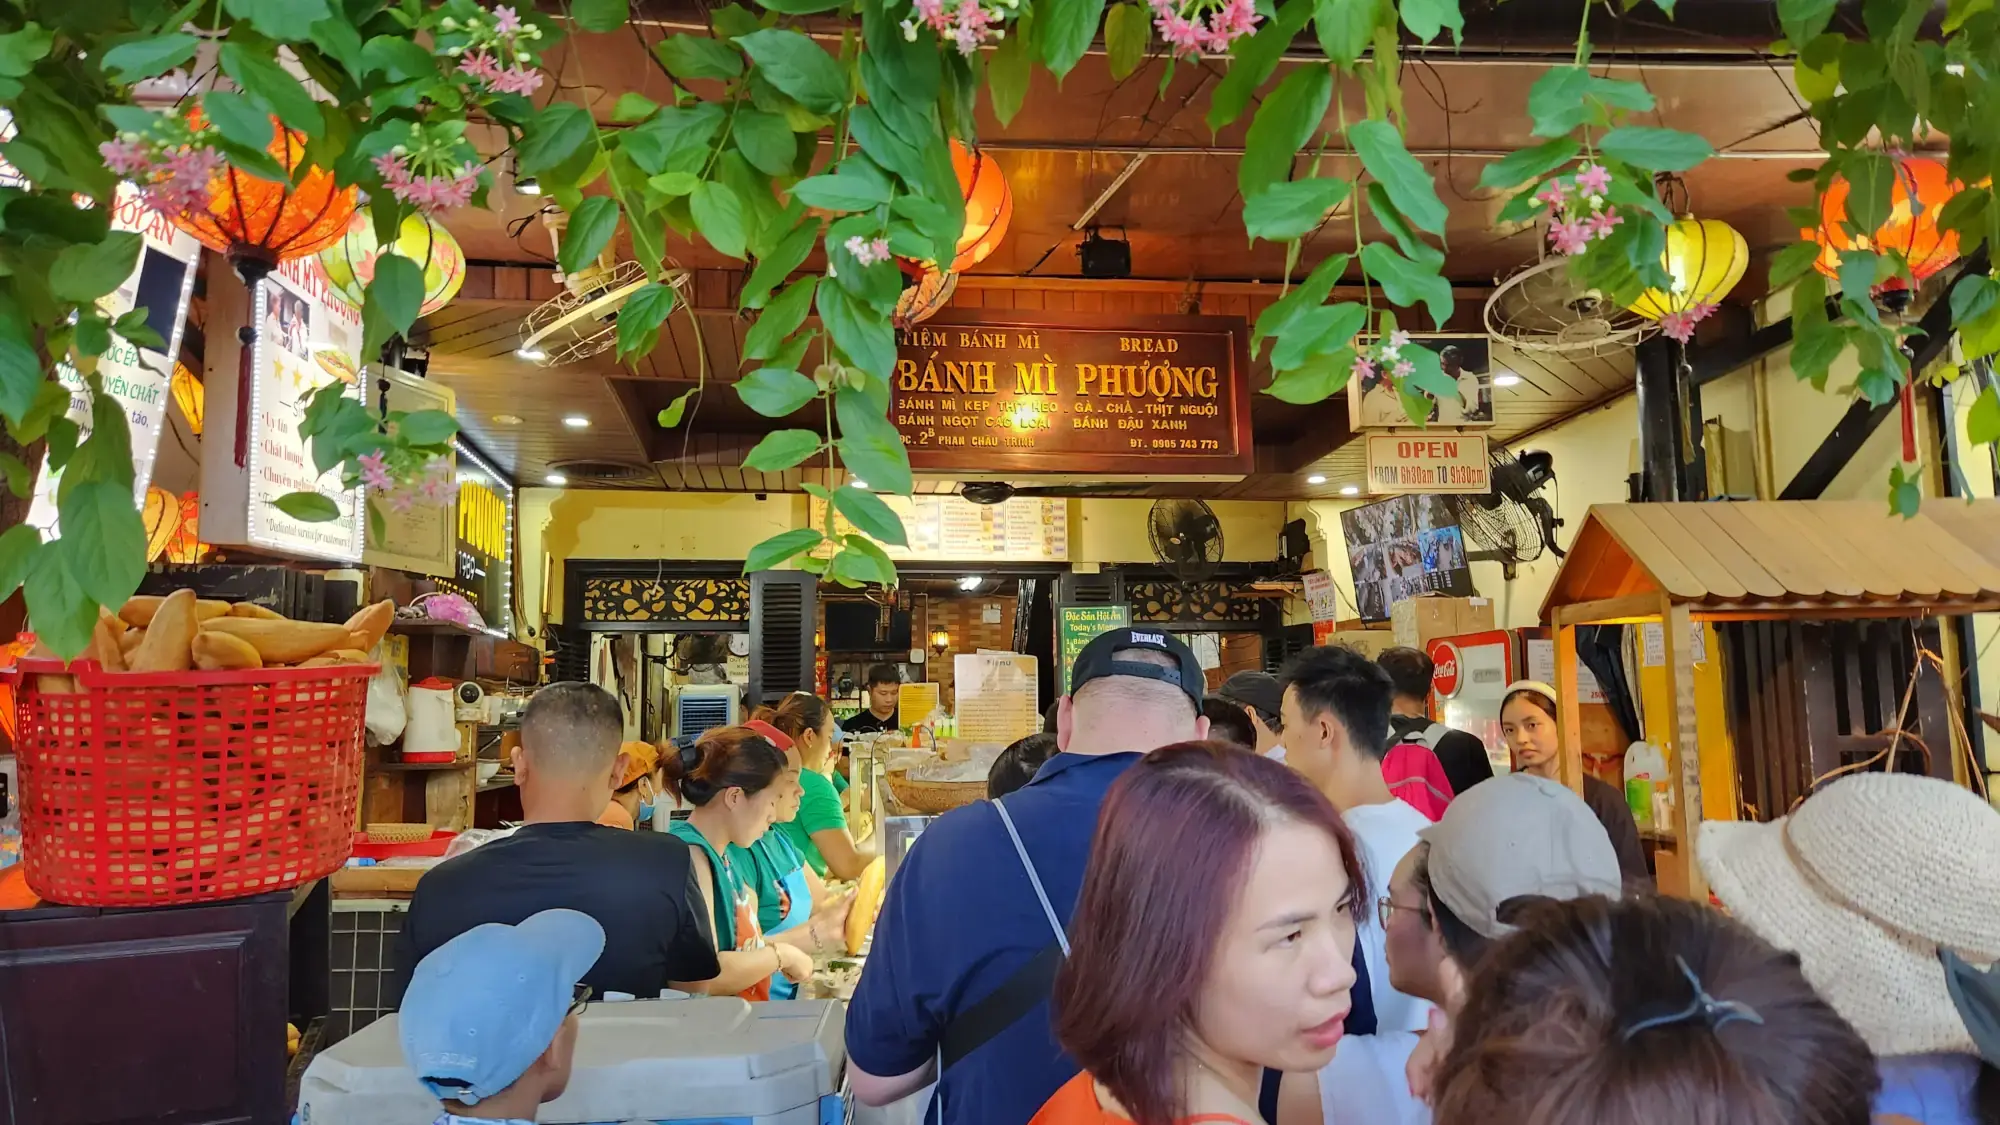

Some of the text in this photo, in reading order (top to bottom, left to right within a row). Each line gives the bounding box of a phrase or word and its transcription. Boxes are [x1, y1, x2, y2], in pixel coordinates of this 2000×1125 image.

[959, 328, 1006, 349] BÁNH
[1018, 330, 1040, 349] MÌ
[1120, 337, 1178, 353] BREAD
[897, 350, 1219, 403] BÁNH MÌ PHƯỢNG
[899, 396, 934, 410] BÁNH
[941, 398, 956, 410] MÌ
[964, 400, 990, 413] KẸP
[1074, 400, 1093, 413] GÀ
[1145, 403, 1174, 417] THỊT
[1180, 403, 1218, 418] NGUỘI
[898, 412, 934, 426] BÁNH
[942, 415, 979, 430] NGỌT
[1073, 416, 1187, 431] BÁNH ĐẬU XANH
[938, 435, 965, 446] PHAN
[1152, 439, 1176, 449] 0905
[1180, 439, 1197, 449] 743
[1200, 440, 1219, 449] 773
[1397, 441, 1458, 459] OPEN
[1374, 465, 1484, 486] FROM 6h30am TO 9h30pm
[1096, 610, 1110, 622] Hội
[1070, 623, 1097, 633] Today's
